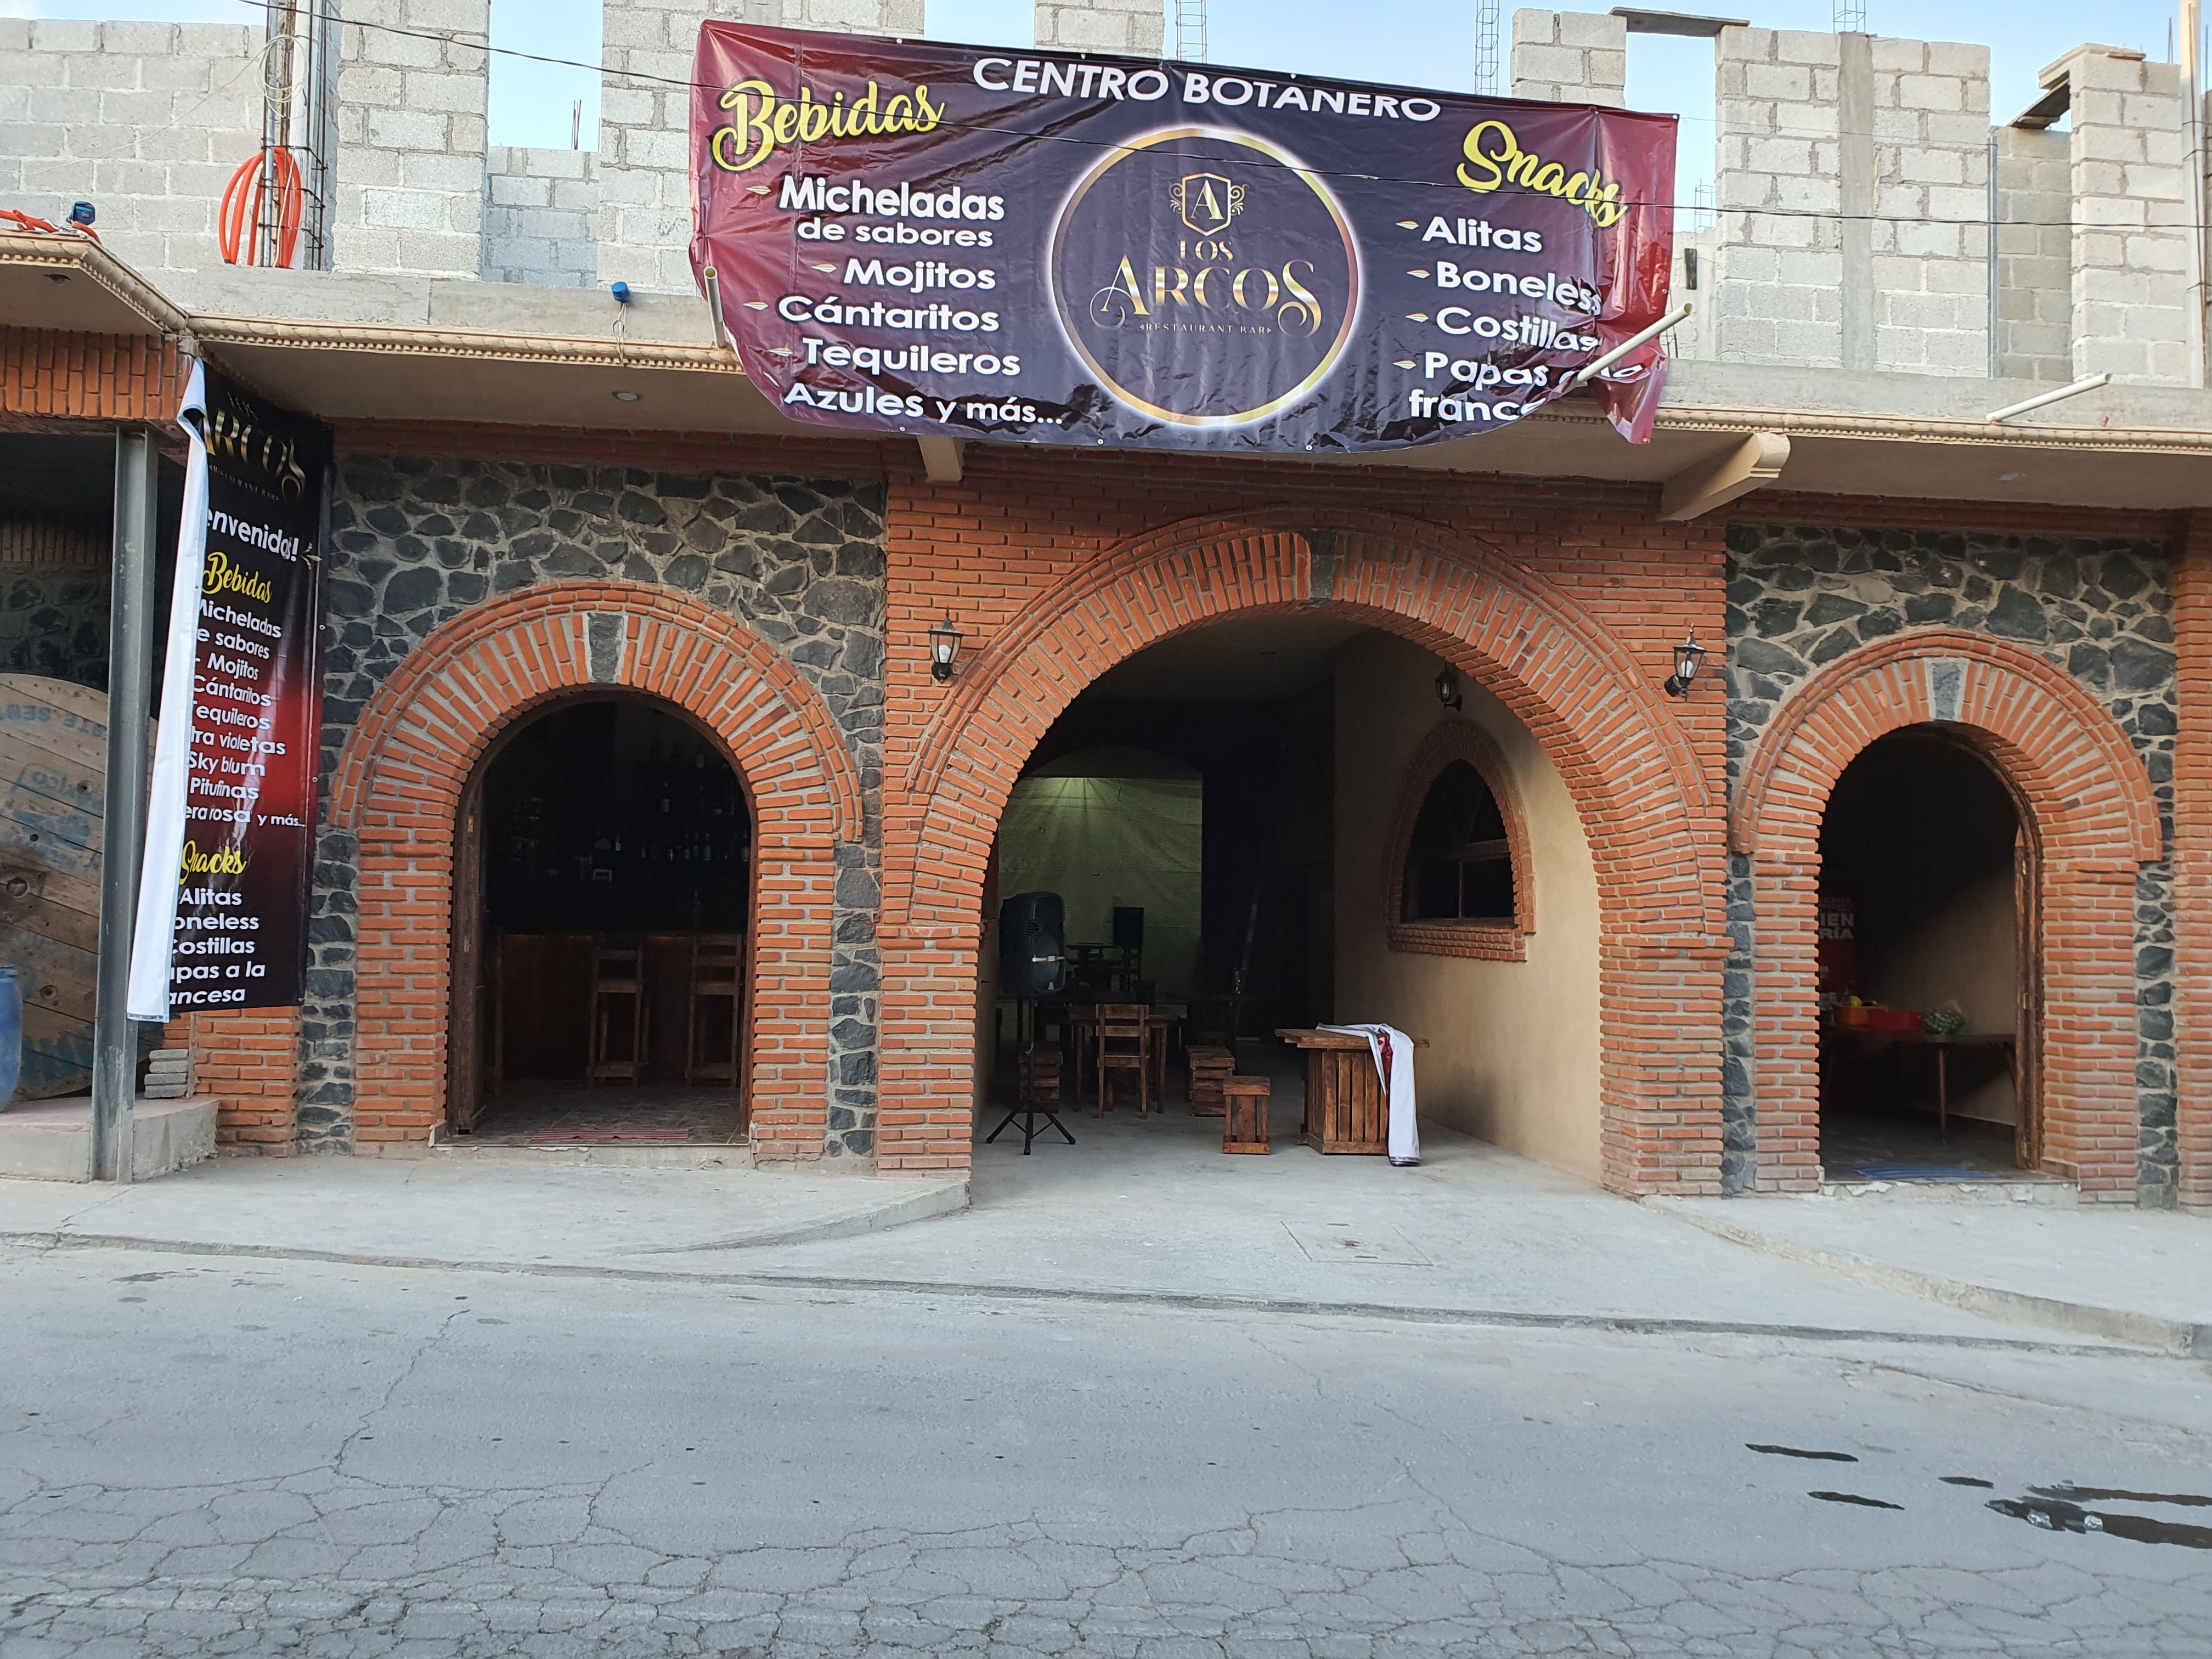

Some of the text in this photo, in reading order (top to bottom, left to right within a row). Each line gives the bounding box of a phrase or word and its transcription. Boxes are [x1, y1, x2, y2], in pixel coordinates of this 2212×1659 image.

[973, 58, 1441, 122] CENTRO BOTANERO
[712, 80, 945, 171] Bebidas
[1457, 120, 1628, 227] Snacks
[778, 175, 1005, 221] Micheladas
[797, 217, 994, 247] de sabores
[1421, 216, 1543, 252] Alitas
[1180, 240, 1234, 262] LOS
[843, 258, 996, 294] Mojitos
[1436, 261, 1602, 316] Boneless
[1090, 253, 1322, 338] ARCOS
[778, 296, 1000, 331] Cántaritos
[1146, 323, 1265, 335] RESTAURANT BAR
[1436, 306, 1601, 352] Costillas
[802, 337, 1021, 376] Tequileros
[1425, 352, 1549, 392] Papas
[783, 382, 1063, 425] Azules y más...
[202, 551, 273, 603] Bebidas
[197, 628, 270, 659] e sabores
[207, 652, 259, 681] Mojitos
[219, 731, 286, 755] violetas
[189, 751, 266, 776] Sky blum
[190, 777, 259, 800] Pitufinas
[208, 808, 251, 823] rosa
[257, 814, 268, 827] y
[179, 840, 247, 885] Snacks
[179, 888, 242, 906] Alitas
[174, 912, 260, 930] oneless
[1819, 927, 1854, 940] RÍA
[1820, 913, 1854, 926] IEN
[225, 964, 240, 978] a
[245, 961, 266, 978] la
